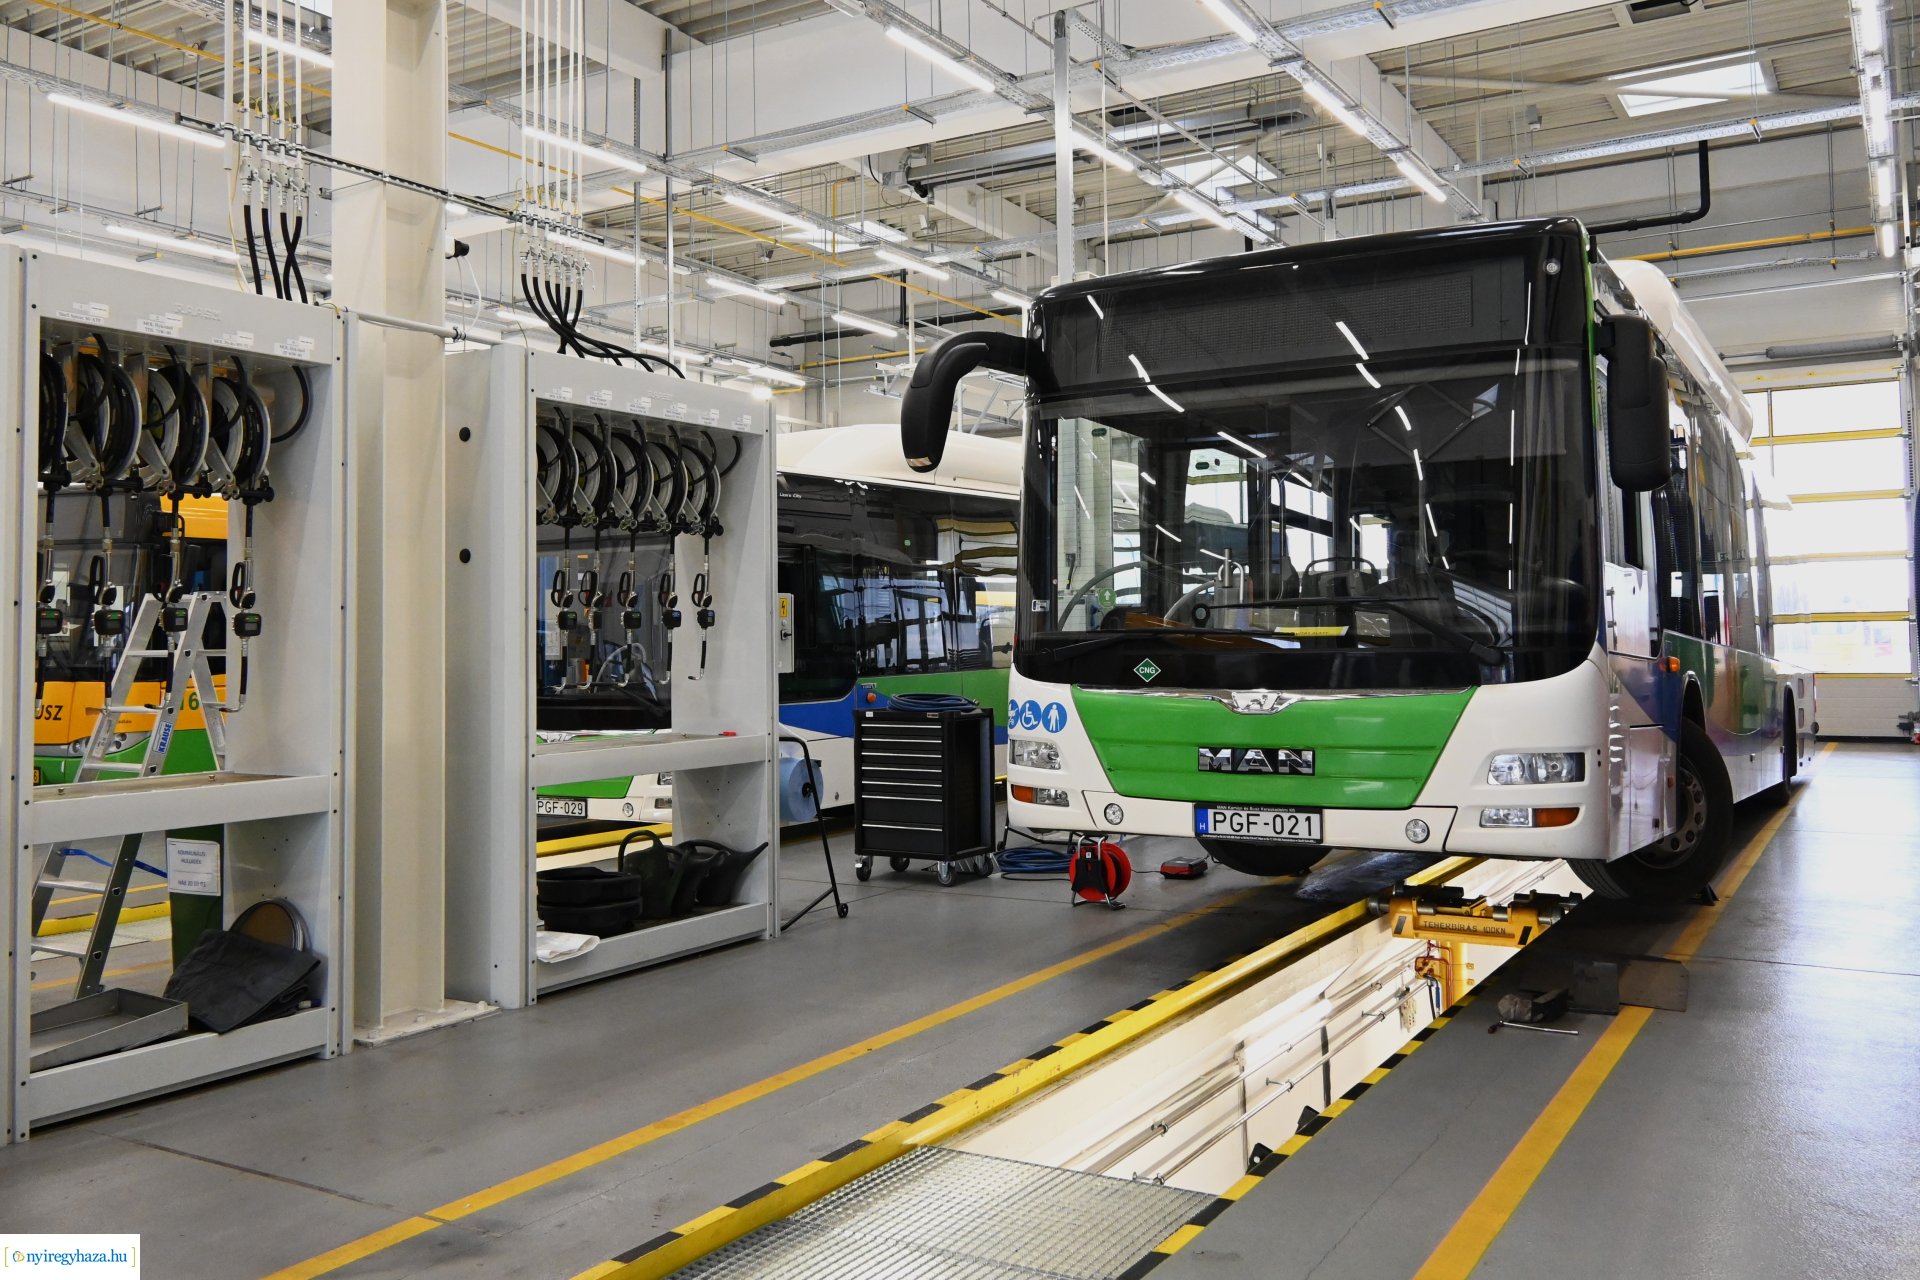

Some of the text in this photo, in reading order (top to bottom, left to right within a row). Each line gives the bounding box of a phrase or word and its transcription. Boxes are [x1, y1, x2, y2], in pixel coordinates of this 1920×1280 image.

[158, 723, 172, 753] KRAUSE
[1198, 748, 1313, 774] MAN
[537, 800, 583, 815] PGF-029
[1200, 822, 1206, 830] H
[1213, 811, 1312, 837] PGF-021
